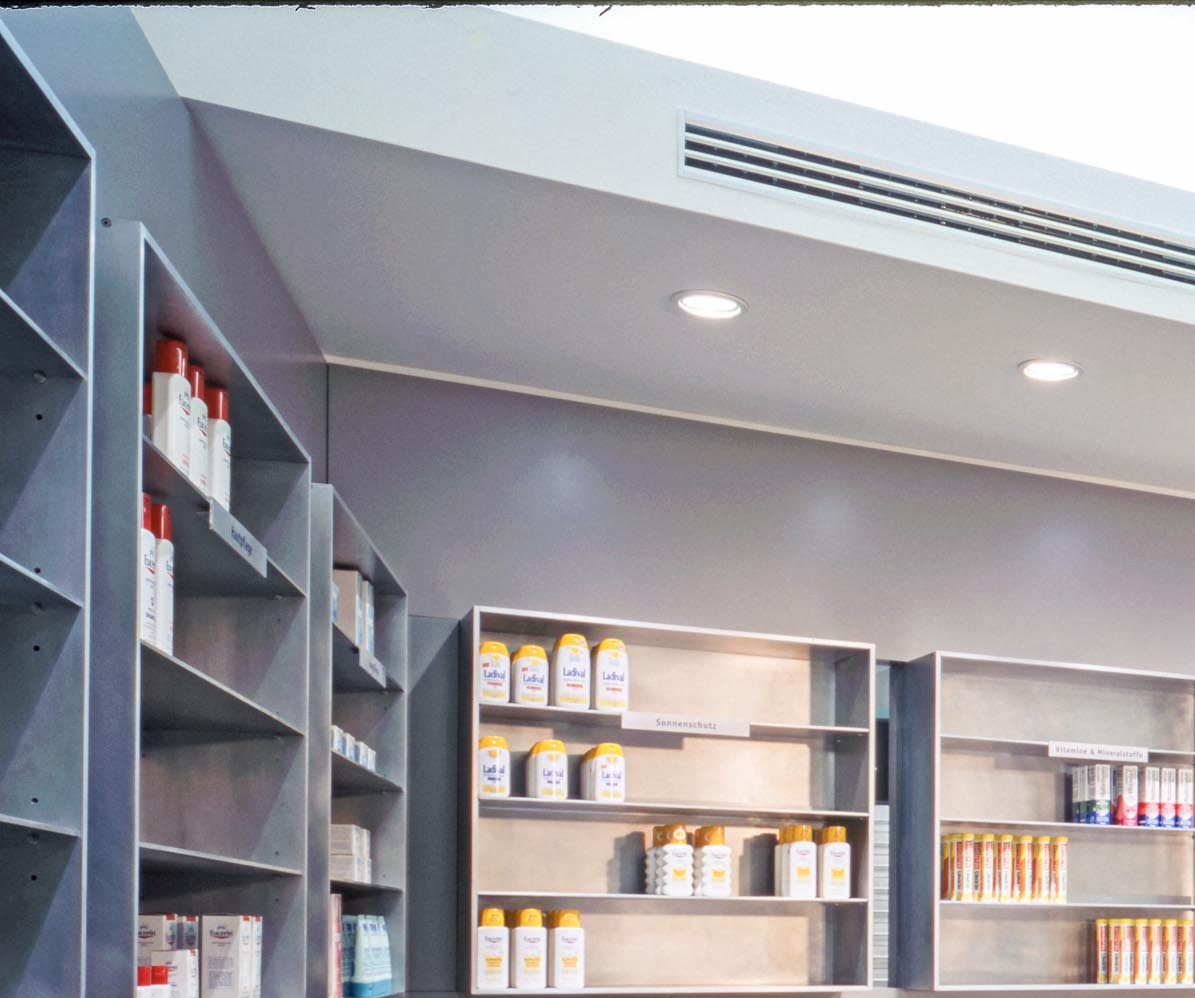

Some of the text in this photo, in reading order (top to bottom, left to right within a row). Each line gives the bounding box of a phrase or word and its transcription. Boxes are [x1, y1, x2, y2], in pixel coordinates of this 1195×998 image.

[484, 669, 506, 681] Ladival
[522, 673, 545, 684] Ladival
[563, 667, 586, 679] Ladival
[603, 671, 625, 682] Ladival
[655, 718, 717, 730] Sonnenschutz
[1055, 746, 1087, 755] Vitamine
